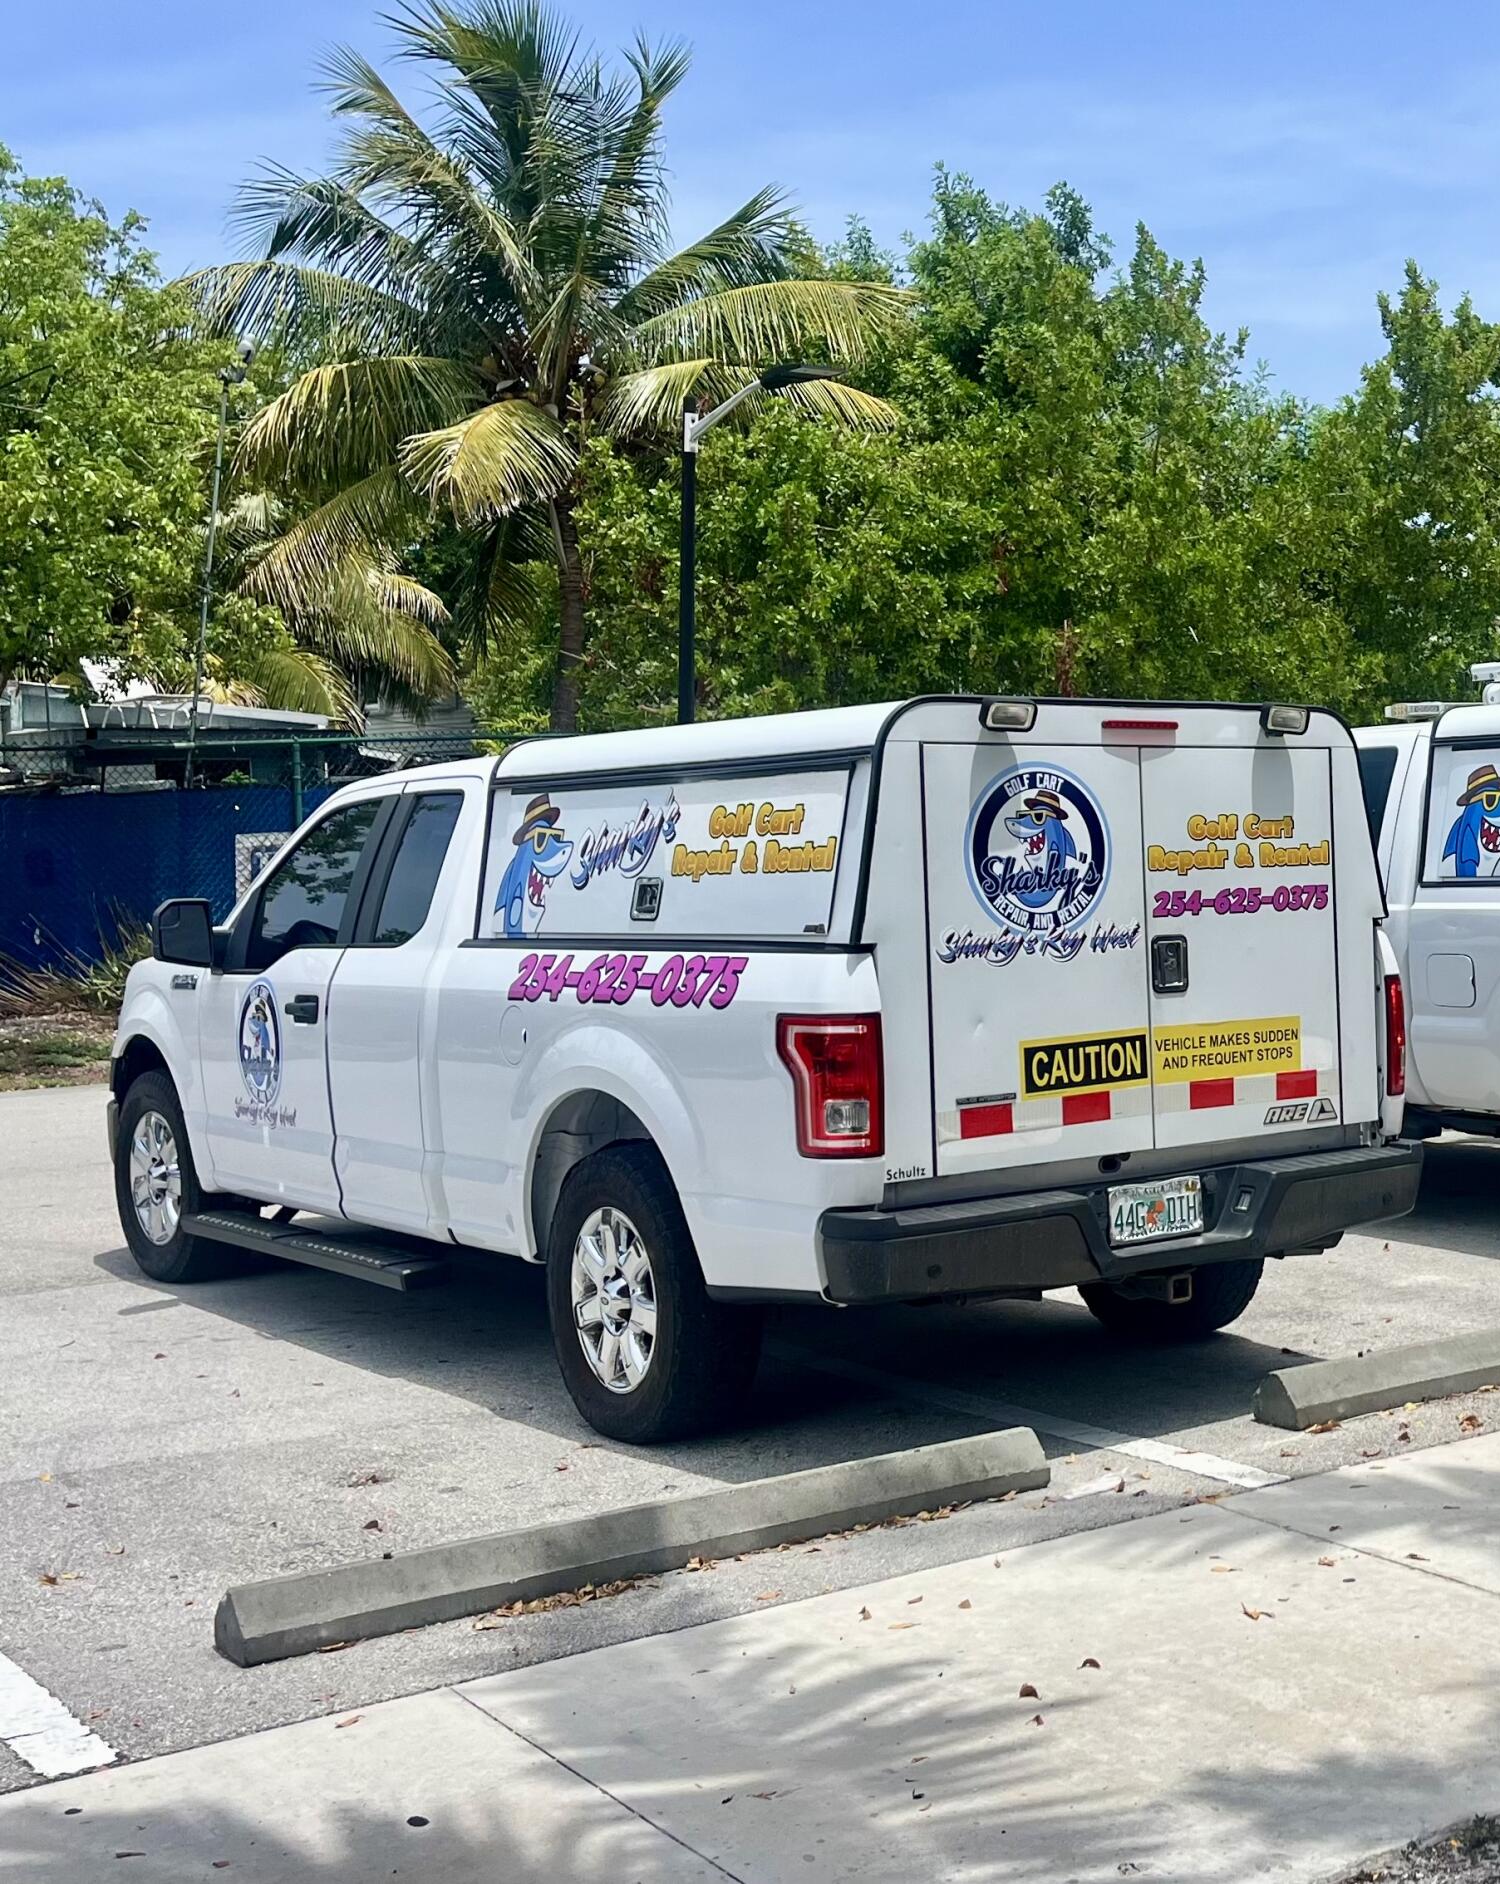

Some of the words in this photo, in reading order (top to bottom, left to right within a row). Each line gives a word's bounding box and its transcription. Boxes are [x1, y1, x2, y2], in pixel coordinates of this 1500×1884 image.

[1003, 773, 1030, 797] GOLF
[1036, 772, 1064, 793] CART
[709, 804, 753, 839] Golf
[756, 802, 805, 836] Cart
[1187, 814, 1238, 841] Golf
[1243, 813, 1294, 839] Cart
[671, 840, 736, 882] Repair
[740, 844, 758, 874] &
[762, 836, 837, 874] Rental
[1148, 842, 1229, 876] Repair
[1234, 843, 1254, 868] &
[1259, 840, 1330, 867] Rental
[992, 894, 1031, 928] REPAIR
[1033, 913, 1054, 929] AND
[1058, 892, 1093, 924] RENTAL
[1152, 884, 1329, 918] 254-625-0375
[1041, 926, 1087, 963] Key
[1090, 918, 1142, 954] West
[507, 954, 750, 1009] 254-625-0375
[1155, 1036, 1206, 1052] VEHICLE
[1209, 1032, 1250, 1047] MAKES
[1253, 1028, 1299, 1043] SUDDEN
[1163, 1056, 1188, 1070] AND
[1192, 1050, 1254, 1067] FREQUENT
[1257, 1046, 1293, 1061] STOPS
[1031, 1040, 1142, 1088] CAUTION
[886, 1167, 926, 1181] Schultz
